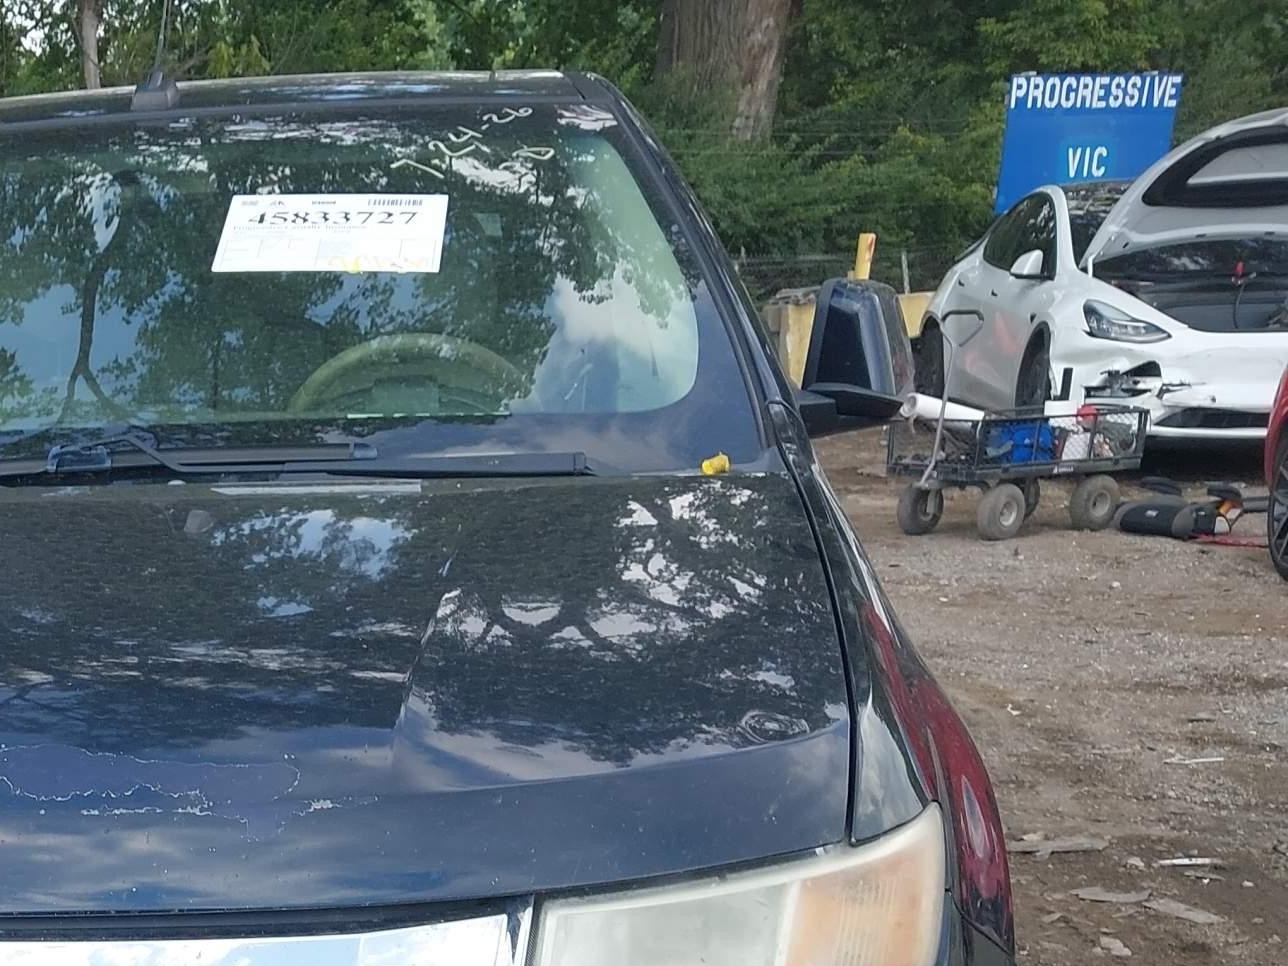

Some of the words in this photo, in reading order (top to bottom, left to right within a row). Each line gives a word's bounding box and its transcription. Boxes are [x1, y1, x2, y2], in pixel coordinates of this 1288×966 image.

[1010, 75, 1183, 109] PROGRESSIVE
[1067, 146, 1108, 178] VIC
[247, 210, 418, 226] 45833727
